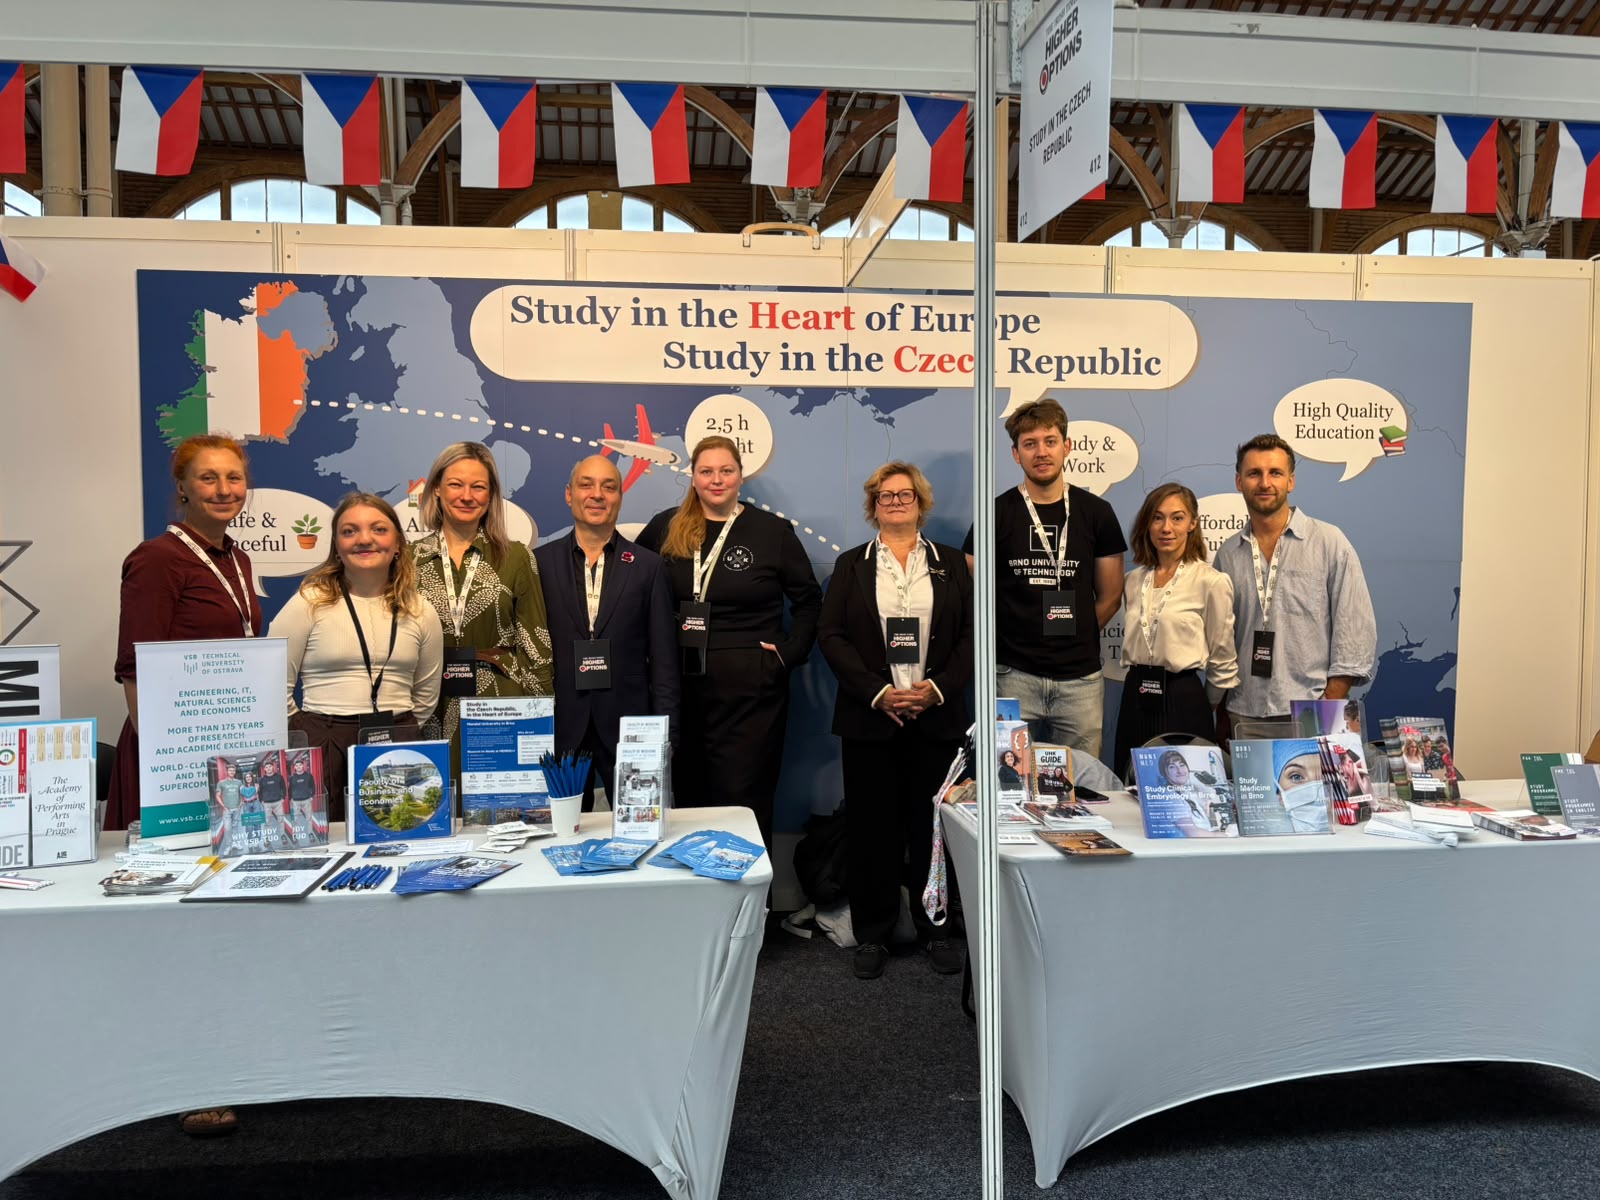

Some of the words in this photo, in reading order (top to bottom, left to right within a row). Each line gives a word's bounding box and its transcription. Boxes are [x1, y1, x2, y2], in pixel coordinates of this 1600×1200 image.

[1045, 6, 1079, 60] HIGHER
[1039, 29, 1082, 95] OPTIONS
[1029, 123, 1047, 153] STUDY
[1048, 116, 1055, 136] IN
[1056, 103, 1068, 128] THE
[1069, 80, 1091, 115] CZECH
[1043, 126, 1072, 165] REPUBLIC
[1089, 154, 1101, 174] 412
[510, 296, 621, 333] Study
[631, 297, 668, 327] in
[678, 298, 738, 329] the
[748, 302, 855, 331] Heart
[865, 303, 905, 332] of
[910, 305, 1041, 341] Eurpe
[663, 341, 771, 378] Study
[780, 342, 816, 371] in
[826, 343, 884, 373] the
[893, 345, 998, 374] Czec
[1008, 347, 1161, 382] Republic
[1293, 401, 1331, 421] High
[1336, 402, 1394, 422] Quality
[706, 417, 733, 434] 2,5
[738, 413, 749, 430] h
[1295, 423, 1375, 440] Education
[1102, 435, 1117, 451] &
[1062, 457, 1106, 473] Work
[227, 511, 256, 528] afe
[261, 511, 277, 528] &
[1008, 558, 1029, 567] BRNO
[1032, 559, 1080, 568] UNIVESITY
[1013, 568, 1021, 576] OF
[1023, 568, 1076, 577] TECHNOLOGY
[178, 687, 240, 698] ENGINEERING,
[242, 687, 252, 695] IT,
[174, 698, 215, 708] NATURAL
[217, 696, 257, 705] SCIENCES
[180, 708, 199, 717] AND
[201, 706, 251, 716] ECONOMICS
[167, 726, 193, 735] MORE
[195, 724, 219, 733] THAN
[222, 723, 236, 731] 175
[237, 721, 264, 730] YEARS
[155, 747, 174, 755] AND
[177, 743, 221, 754] ACADEMIC
[224, 739, 276, 750] EXCELLENCE
[1040, 755, 1062, 764] GUIDE
[53, 776, 68, 785] The
[175, 772, 193, 780] AND
[196, 771, 208, 779] TH
[1239, 777, 1258, 785] Study
[38, 785, 82, 795] Academy
[1144, 785, 1165, 793] Study
[1166, 784, 1195, 792] Clinical
[56, 793, 66, 803] of
[1146, 791, 1189, 801] Embryology
[35, 802, 86, 813] Performing
[51, 811, 70, 820] Arts
[158, 814, 209, 825] www.vsb.cz/
[45, 827, 77, 837] Prague
[231, 832, 249, 840] WHY
[252, 827, 278, 837] STUDY
